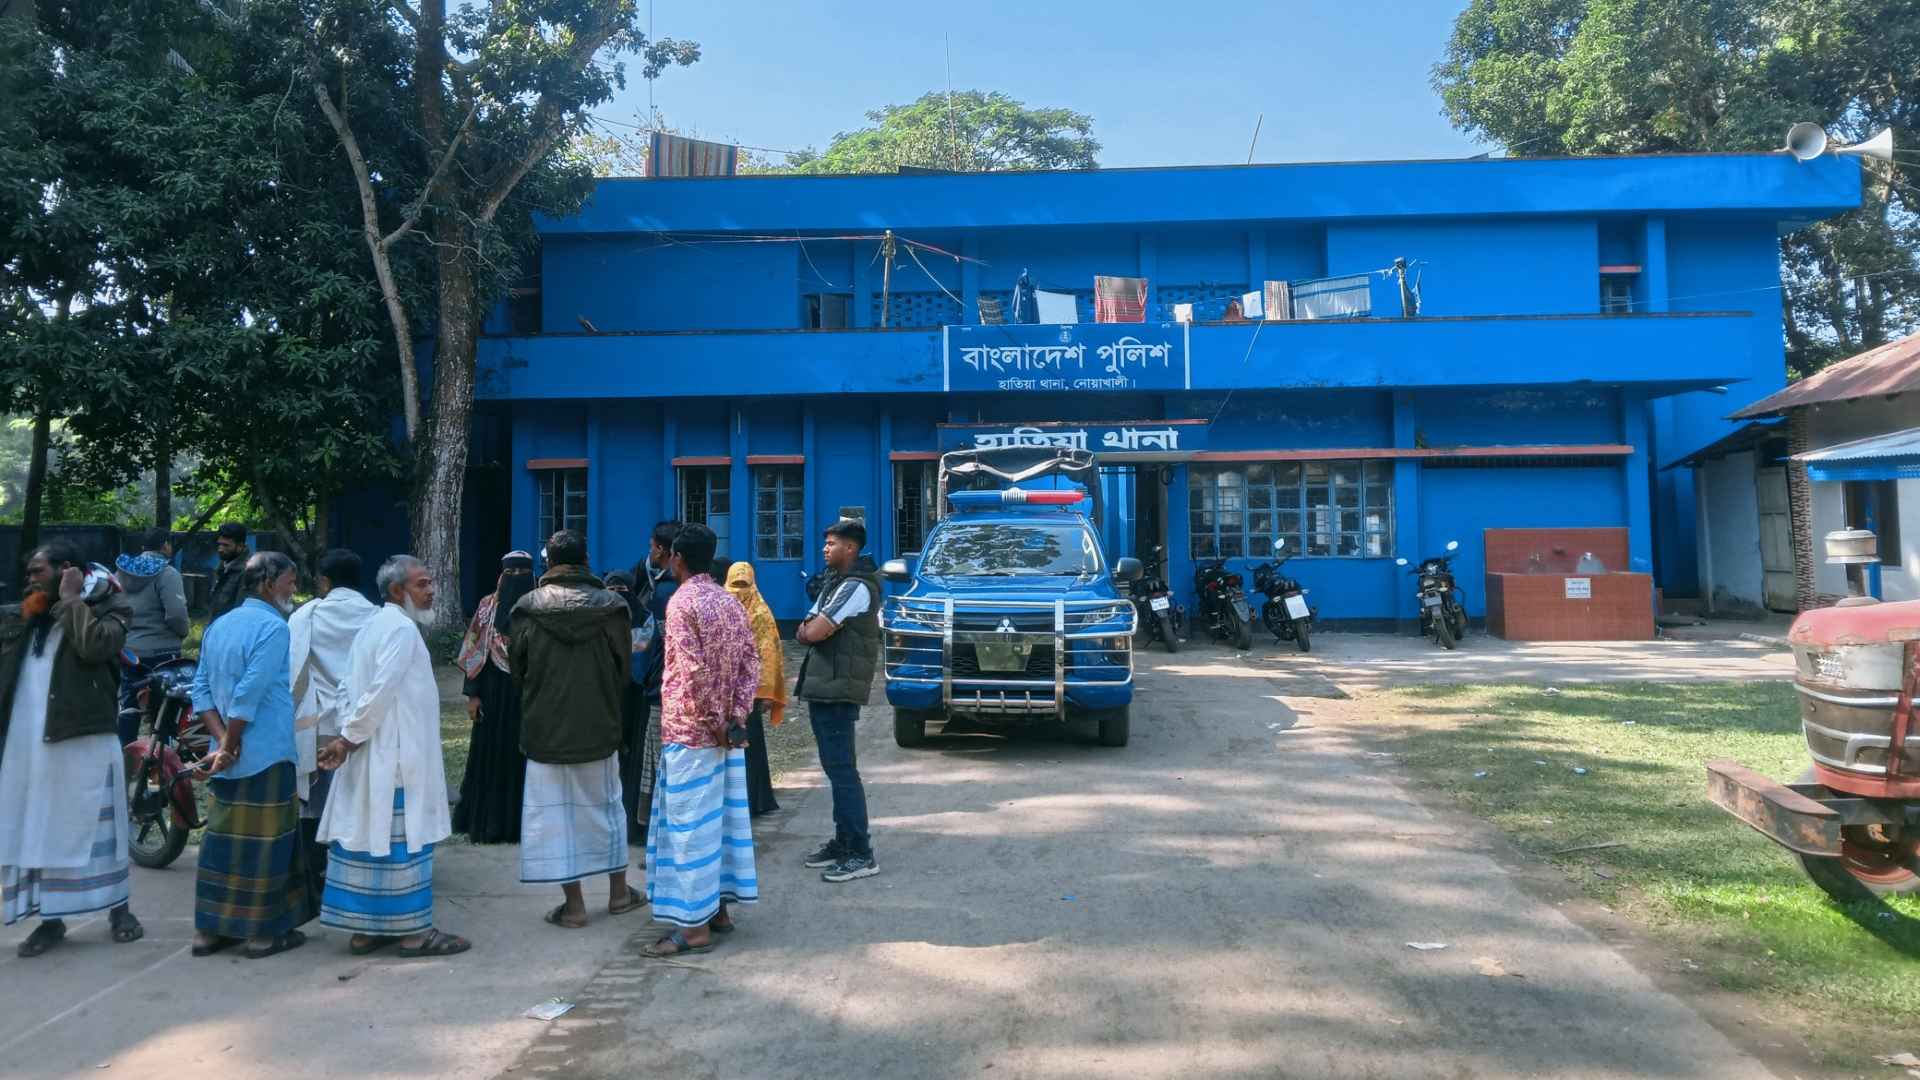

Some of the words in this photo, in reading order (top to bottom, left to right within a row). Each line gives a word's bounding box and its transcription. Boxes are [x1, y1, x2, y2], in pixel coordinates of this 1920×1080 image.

[960, 342, 1087, 372] বাংলাদেশ
[1096, 336, 1173, 374] পুলিশ
[1102, 427, 1179, 450] থানা
